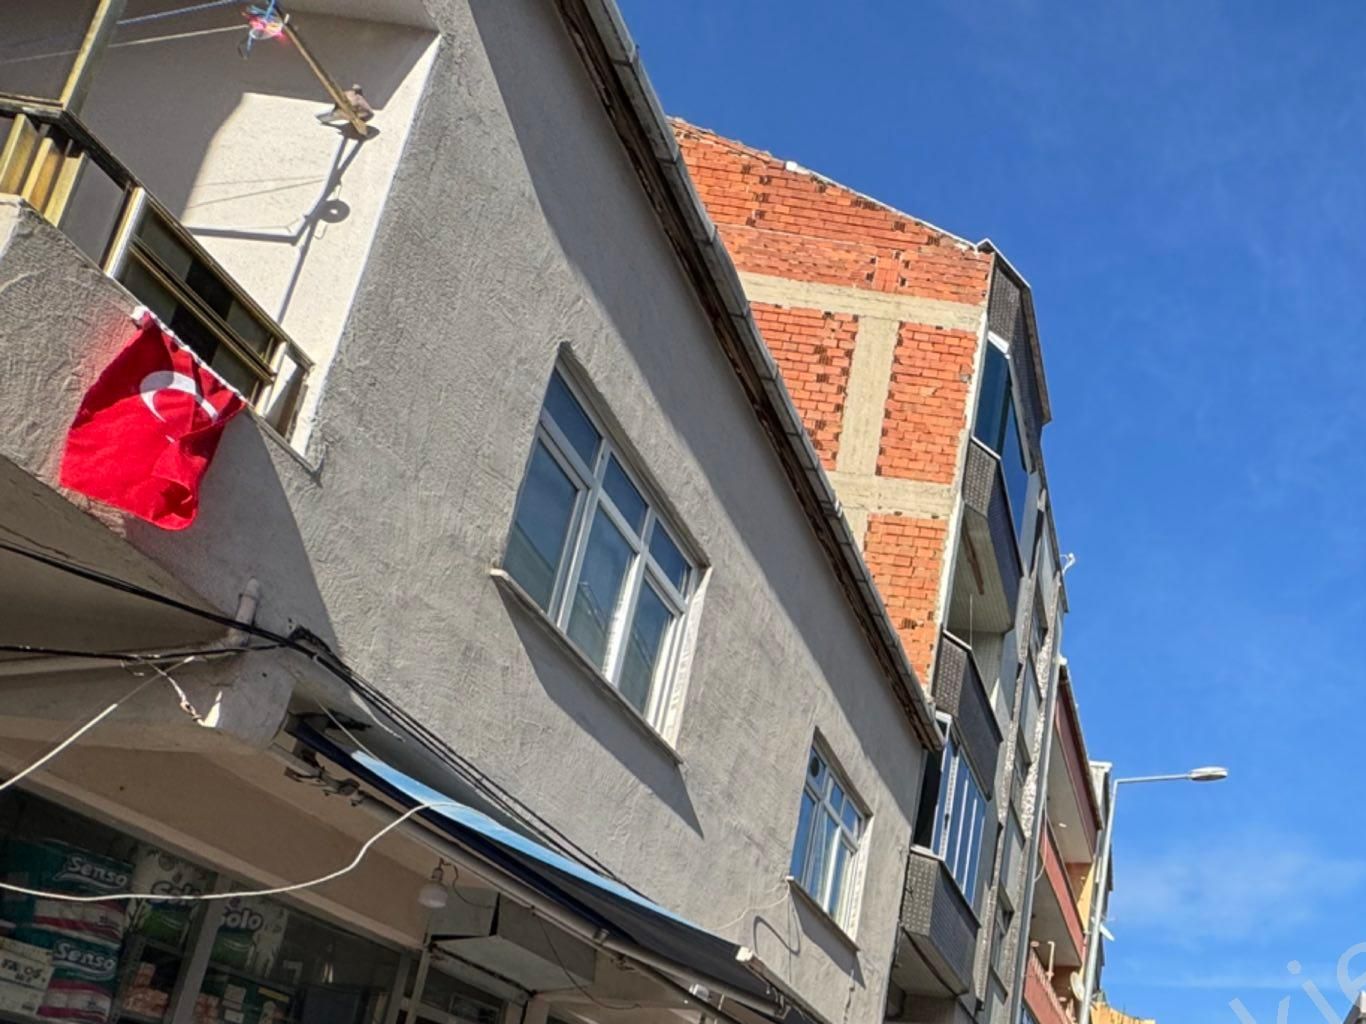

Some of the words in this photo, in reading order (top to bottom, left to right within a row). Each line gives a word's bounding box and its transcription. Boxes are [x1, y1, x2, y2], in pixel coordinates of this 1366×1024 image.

[67, 854, 129, 887] Senso
[220, 905, 265, 931] olo
[53, 939, 117, 969] Senso
